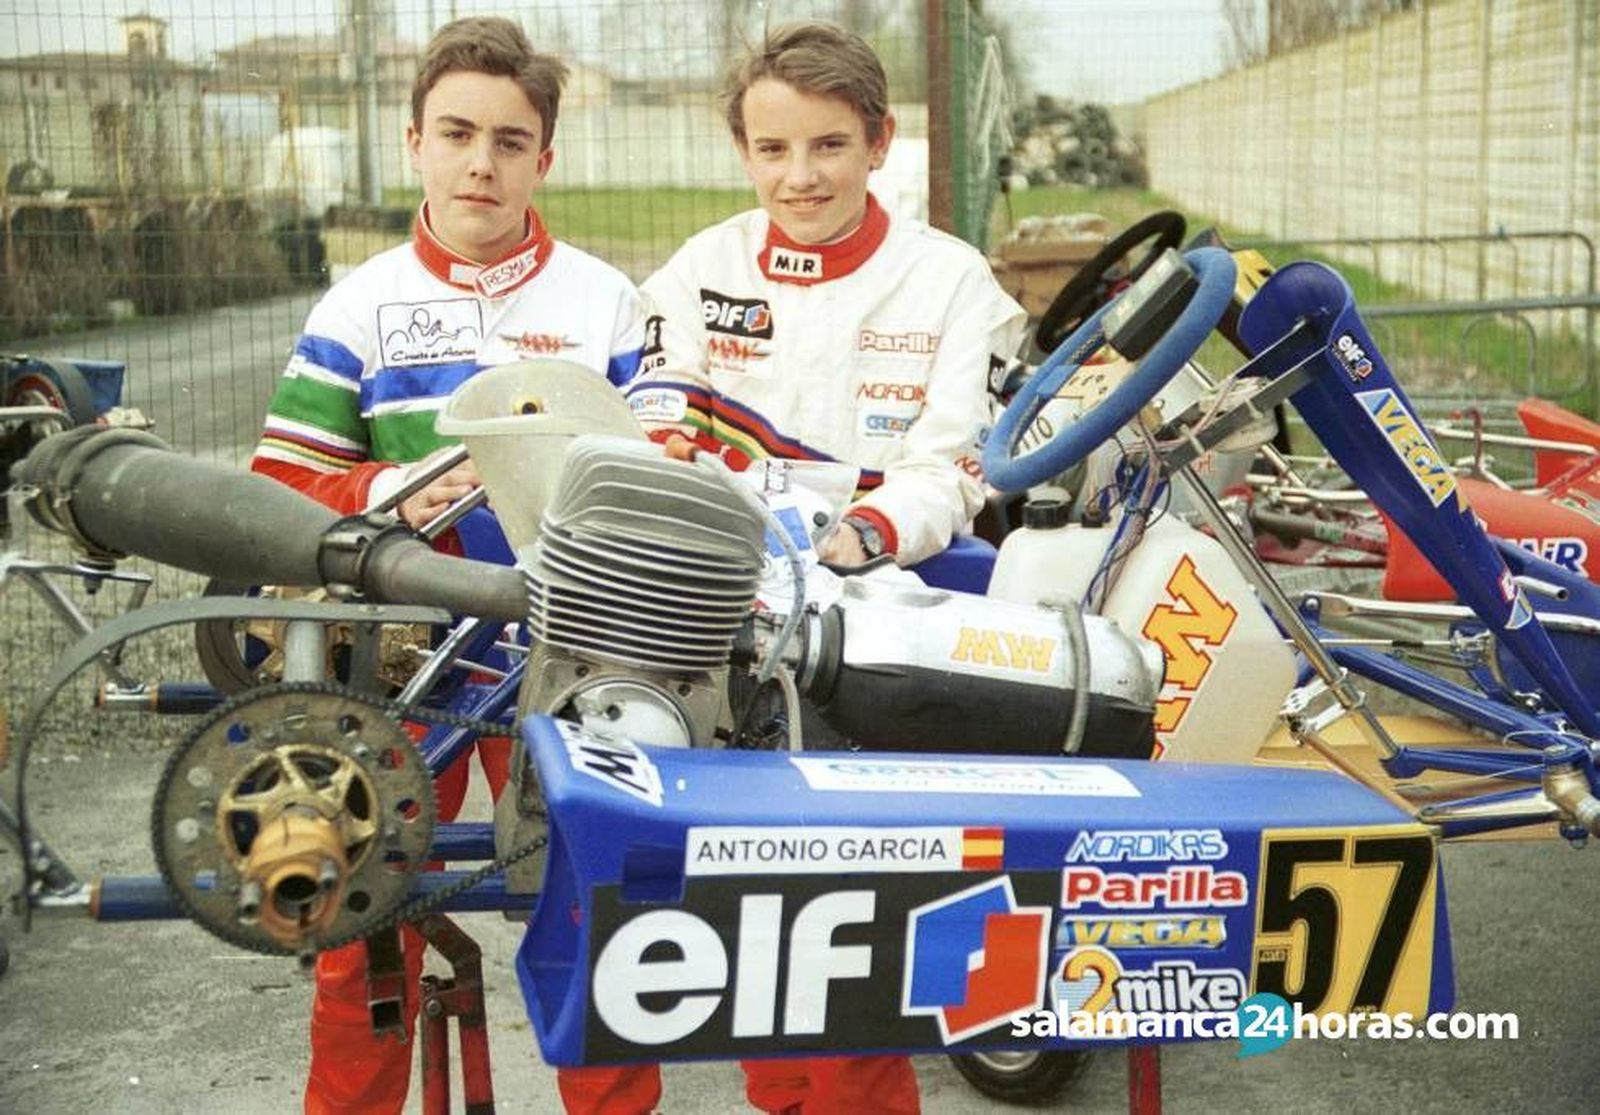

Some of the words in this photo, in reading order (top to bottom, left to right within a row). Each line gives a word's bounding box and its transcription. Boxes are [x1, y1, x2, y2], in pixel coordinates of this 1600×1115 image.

[702, 300, 745, 328] elf
[1338, 335, 1366, 362] elf
[1374, 394, 1456, 505] VEGA
[696, 839, 828, 862] ANTONIO
[837, 838, 947, 861] GARCIA
[1068, 831, 1226, 860] NORDIKAS
[1066, 870, 1244, 903] Parilla
[1072, 919, 1224, 947] VEGA
[1256, 836, 1434, 1018] 57
[592, 890, 877, 1046] elf
